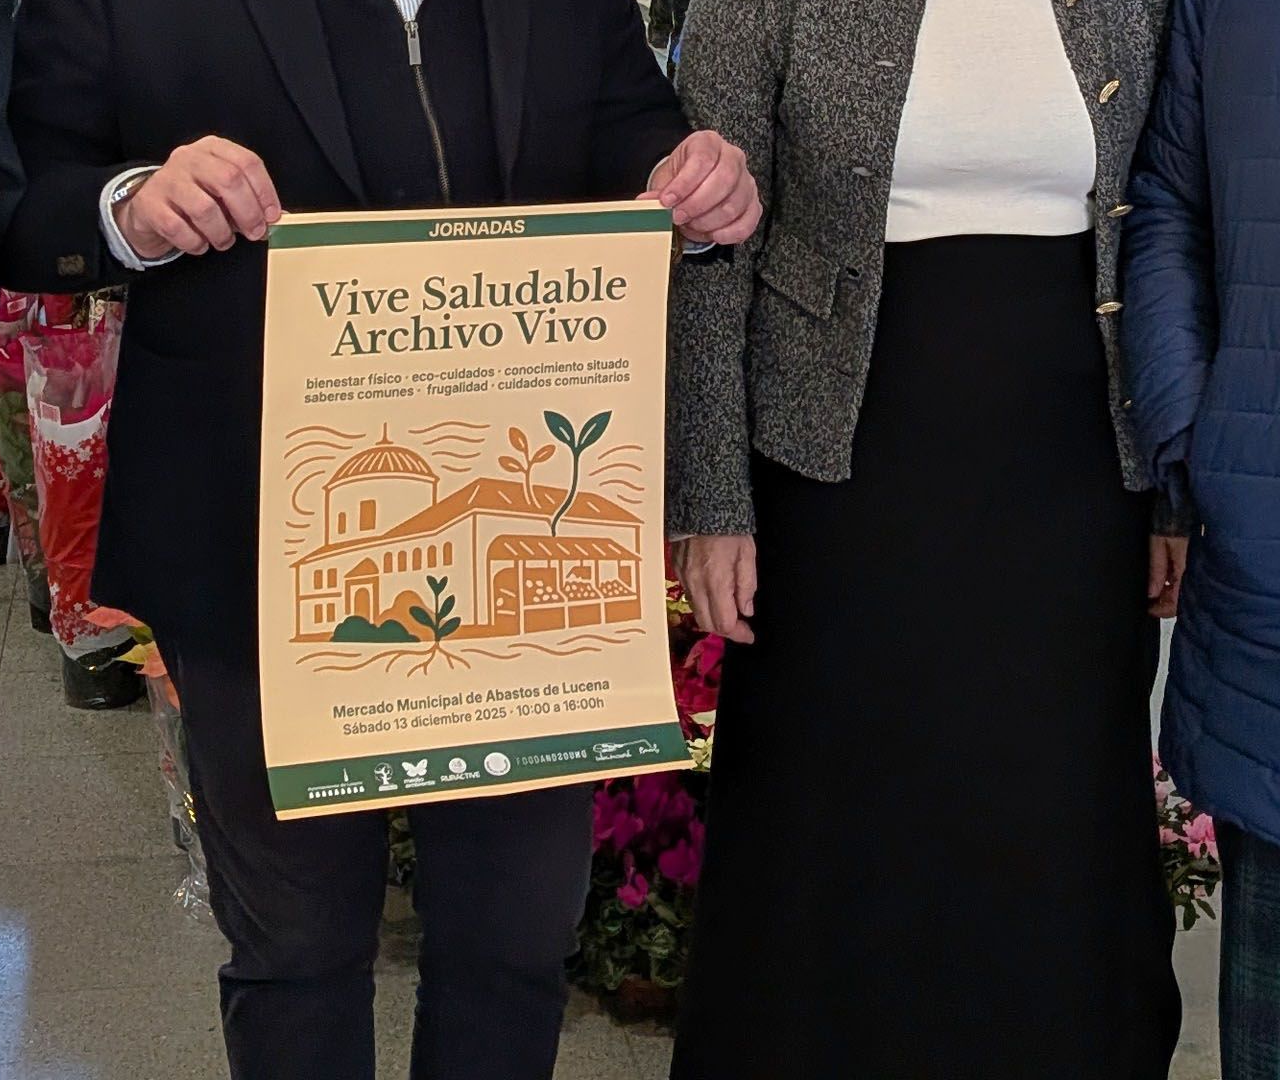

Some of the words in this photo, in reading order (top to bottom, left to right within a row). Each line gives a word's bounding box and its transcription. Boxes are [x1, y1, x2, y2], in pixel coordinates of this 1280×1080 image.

[428, 219, 526, 238] JORNADAS
[312, 278, 410, 318] Vive
[422, 265, 627, 311] Saludable
[331, 313, 503, 357] Archivo
[512, 307, 607, 344] Vivo
[304, 390, 354, 404] saberes
[357, 387, 414, 400] comunes
[426, 380, 488, 397] frugalidad
[497, 376, 552, 391] cuidados
[554, 372, 630, 386] comunitarios
[306, 375, 364, 389] bienestar
[368, 373, 402, 386] físico
[412, 367, 495, 382] eco-cuidados
[504, 361, 584, 376] conocimiento
[586, 358, 629, 371] situado
[333, 701, 394, 719] Mercado
[396, 693, 463, 712] Municipal
[465, 691, 482, 704] de
[486, 687, 540, 702] Abastos
[543, 684, 559, 696] de
[562, 680, 610, 694] Lucena
[343, 719, 391, 735] Sábado
[394, 718, 408, 730] 13
[411, 711, 472, 728] diciembre
[475, 707, 507, 721] 2025
[516, 702, 550, 717] 10:00
[553, 704, 561, 713] a
[563, 697, 605, 711] 16:00h
